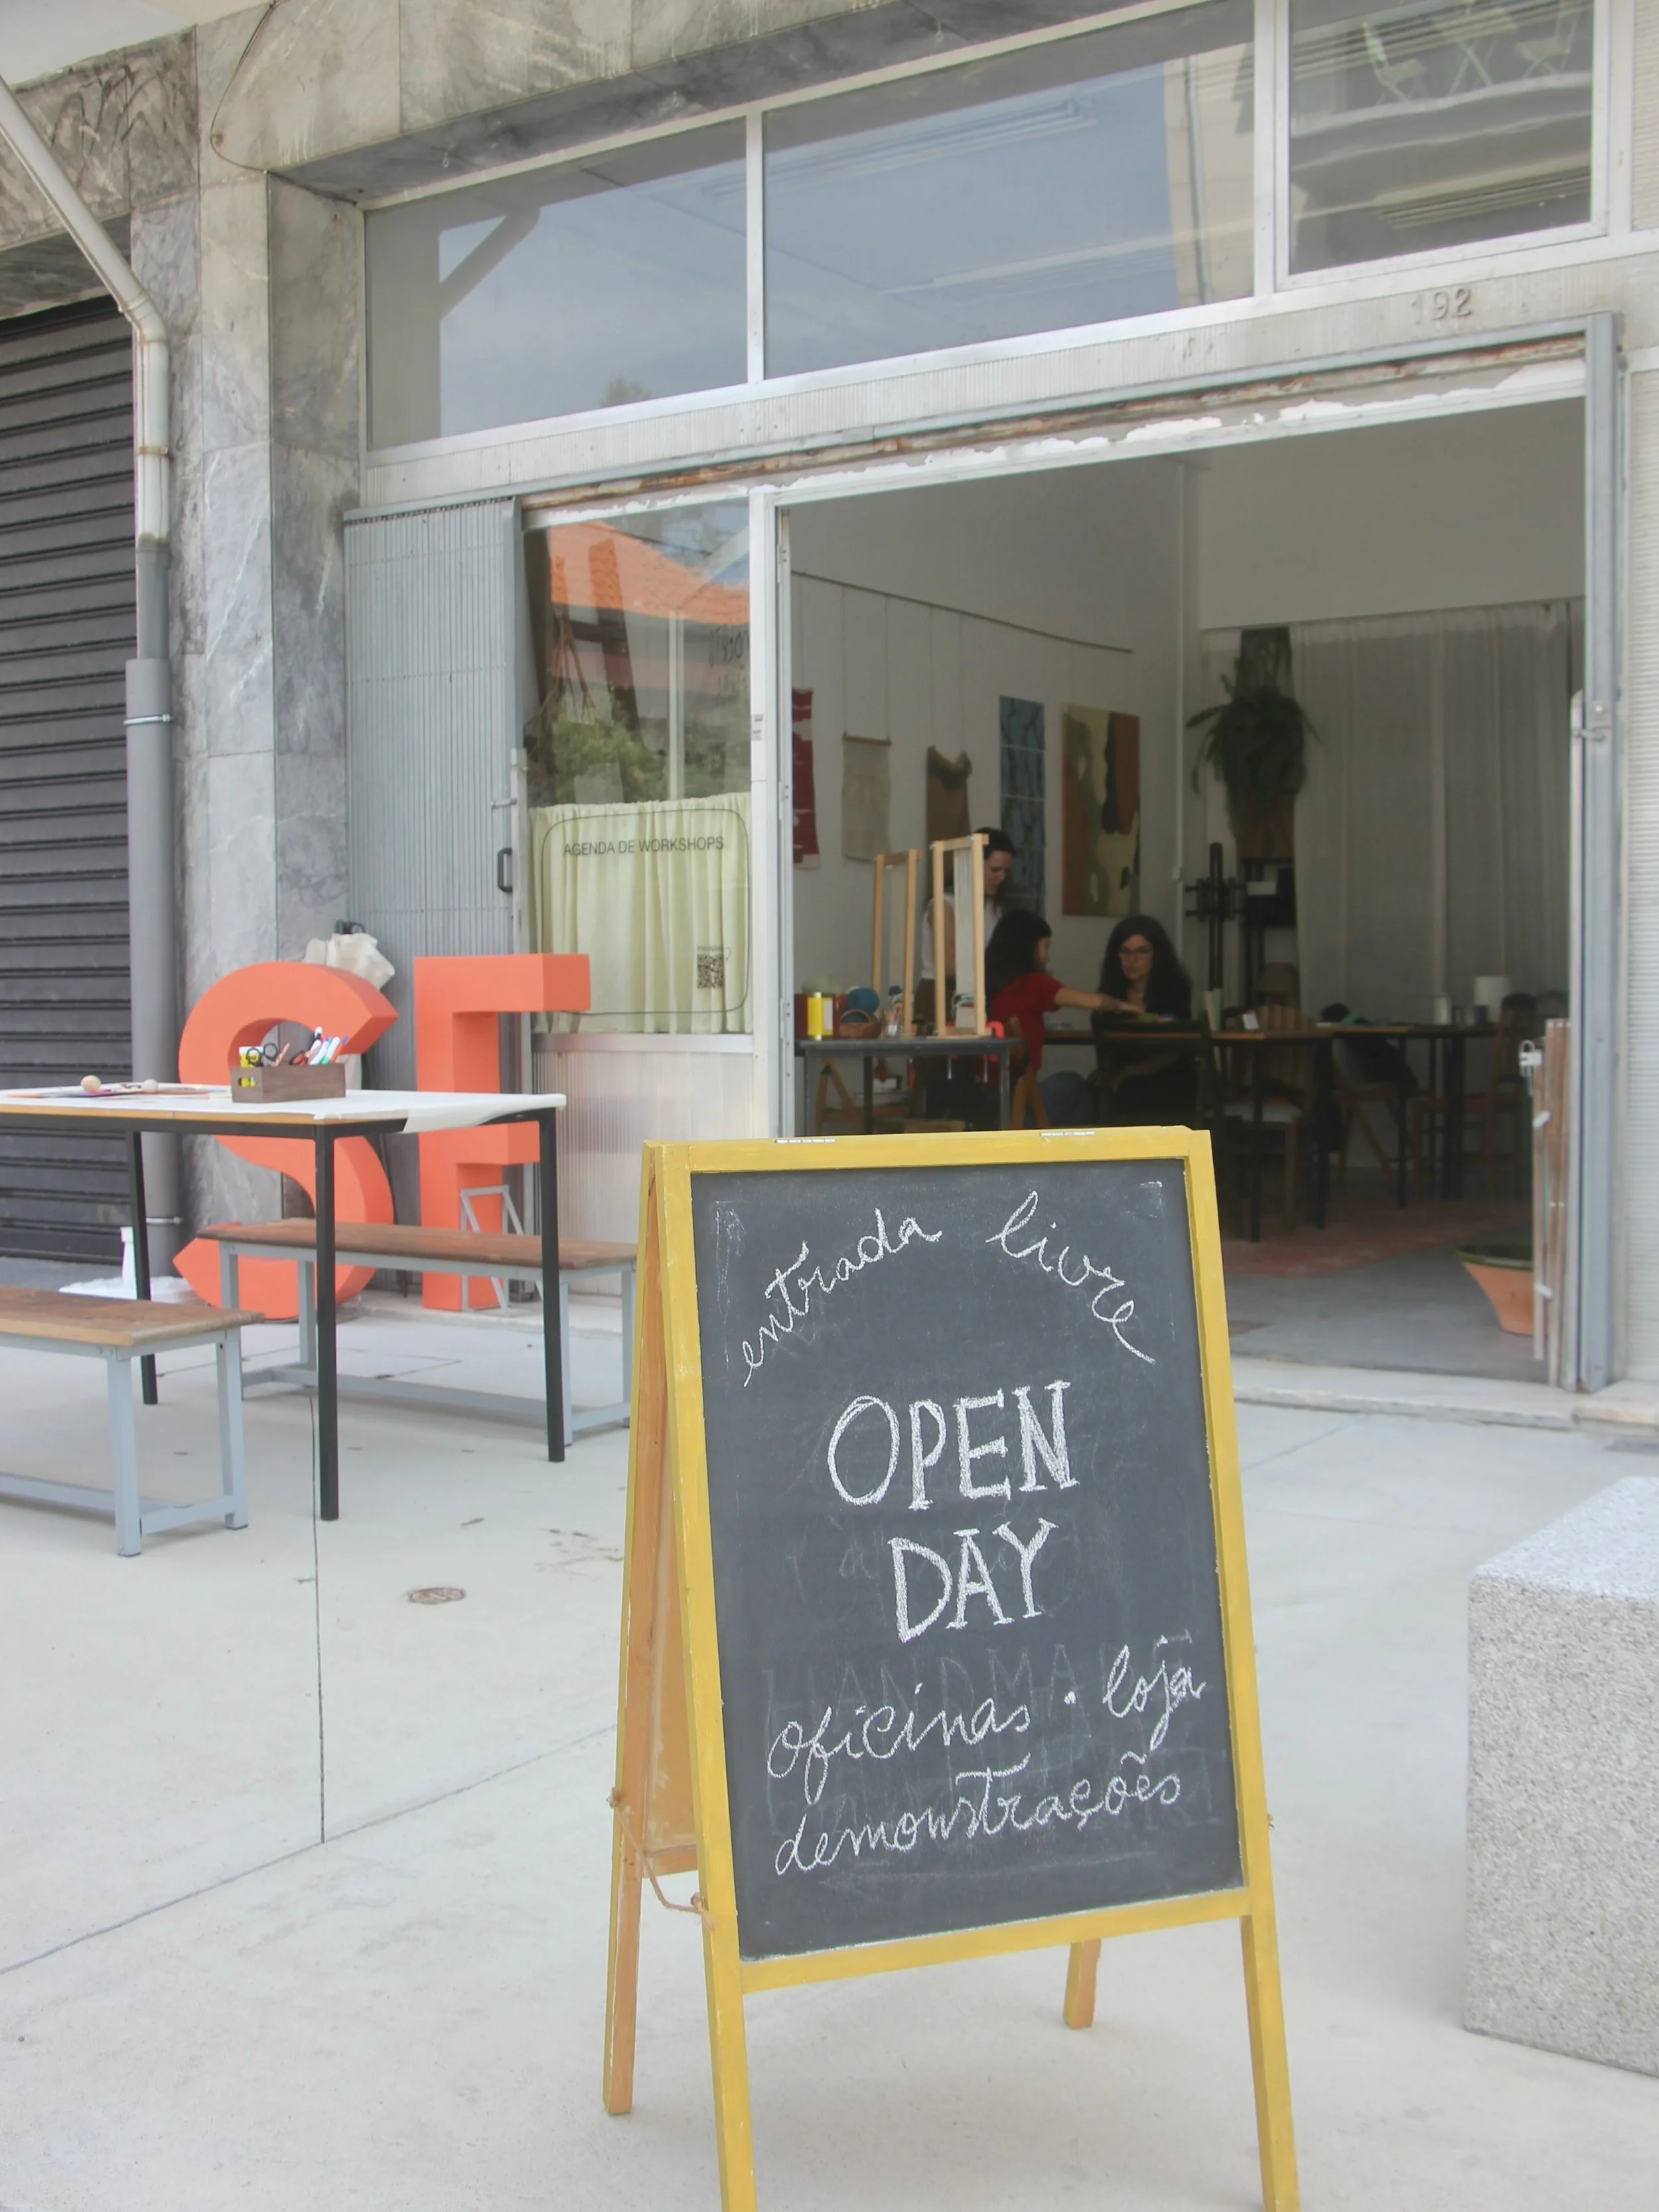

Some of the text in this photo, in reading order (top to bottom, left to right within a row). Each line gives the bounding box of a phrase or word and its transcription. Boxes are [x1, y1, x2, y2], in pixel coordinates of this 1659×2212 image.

[1411, 287, 1473, 325] 192
[563, 836, 724, 856] AGENDA DE WORKSHOPS
[742, 1191, 1155, 1387] entrada livre
[827, 1380, 1079, 1511] OPEN
[887, 1518, 1058, 1643] DAY
[767, 1683, 1030, 1805] oficinas
[1102, 1635, 1206, 1751] loja
